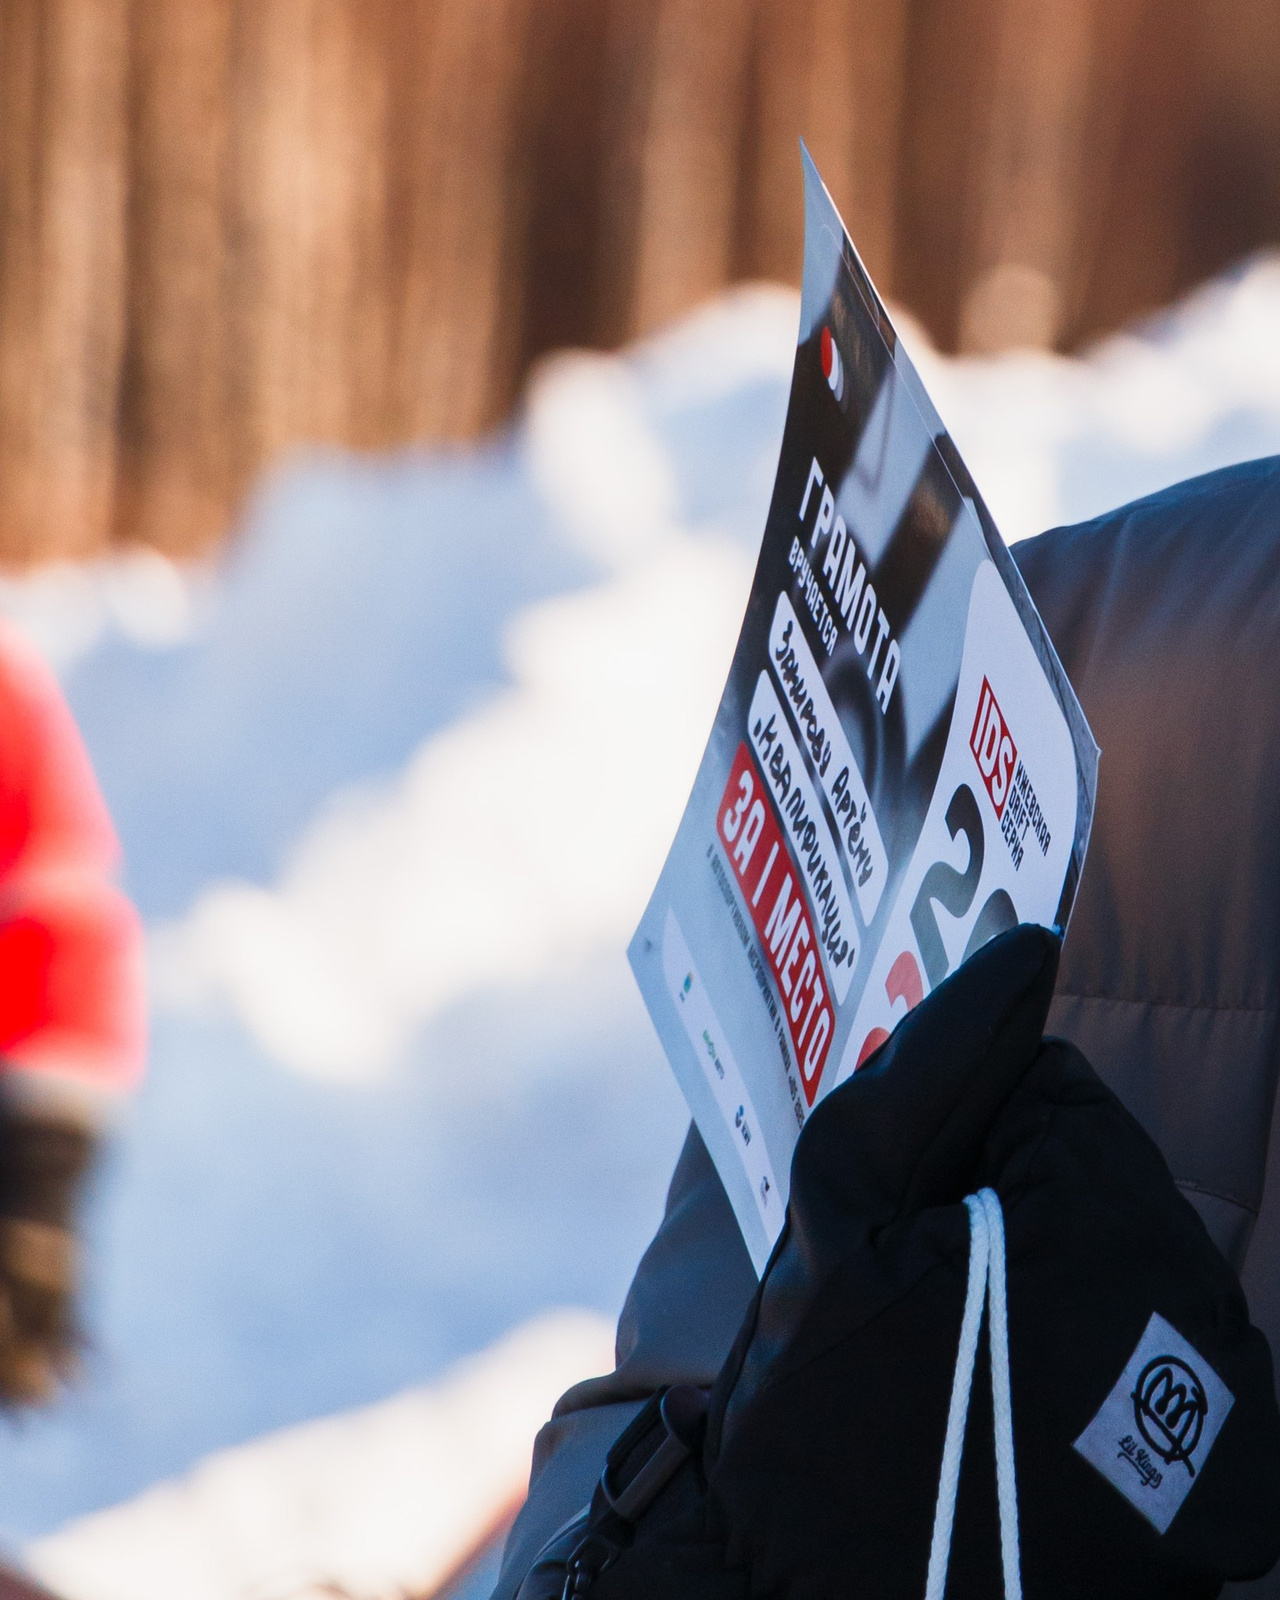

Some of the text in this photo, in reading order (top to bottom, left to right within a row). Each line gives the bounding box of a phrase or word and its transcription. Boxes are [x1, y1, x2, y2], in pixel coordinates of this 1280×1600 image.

[788, 535, 839, 657] ВРУЧАЕТСЯ
[798, 455, 901, 716] ГРАМОТА
[973, 686, 1013, 807] IDS
[1001, 809, 1025, 872] СЕРИЯ
[1008, 784, 1031, 841] DRIFT
[1014, 759, 1052, 857] ИЖЕВСКАЯ
[722, 769, 765, 877] ЗА
[764, 872, 837, 1083] МЕСТО
